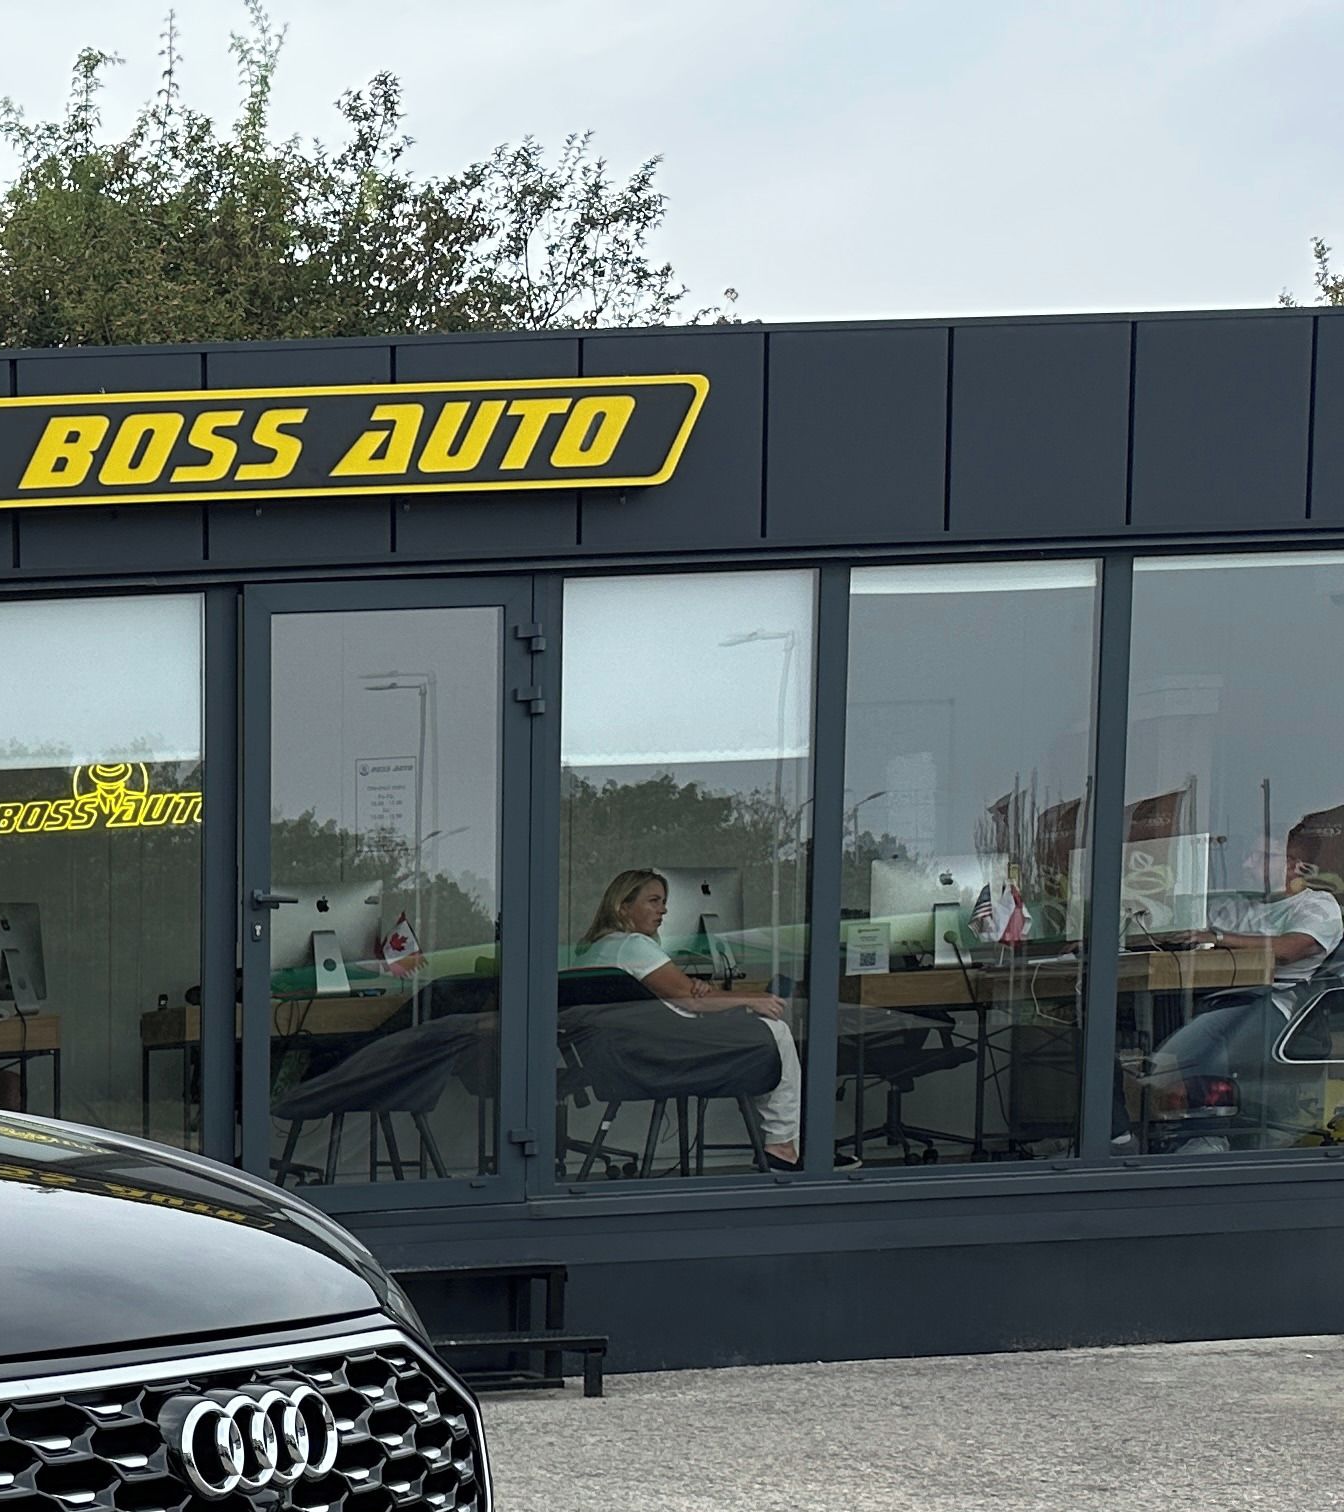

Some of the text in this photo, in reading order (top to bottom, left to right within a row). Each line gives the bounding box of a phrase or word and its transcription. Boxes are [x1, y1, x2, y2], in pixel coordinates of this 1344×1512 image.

[18, 395, 636, 489] BOSS AUTO
[106, 791, 202, 828] AUT
